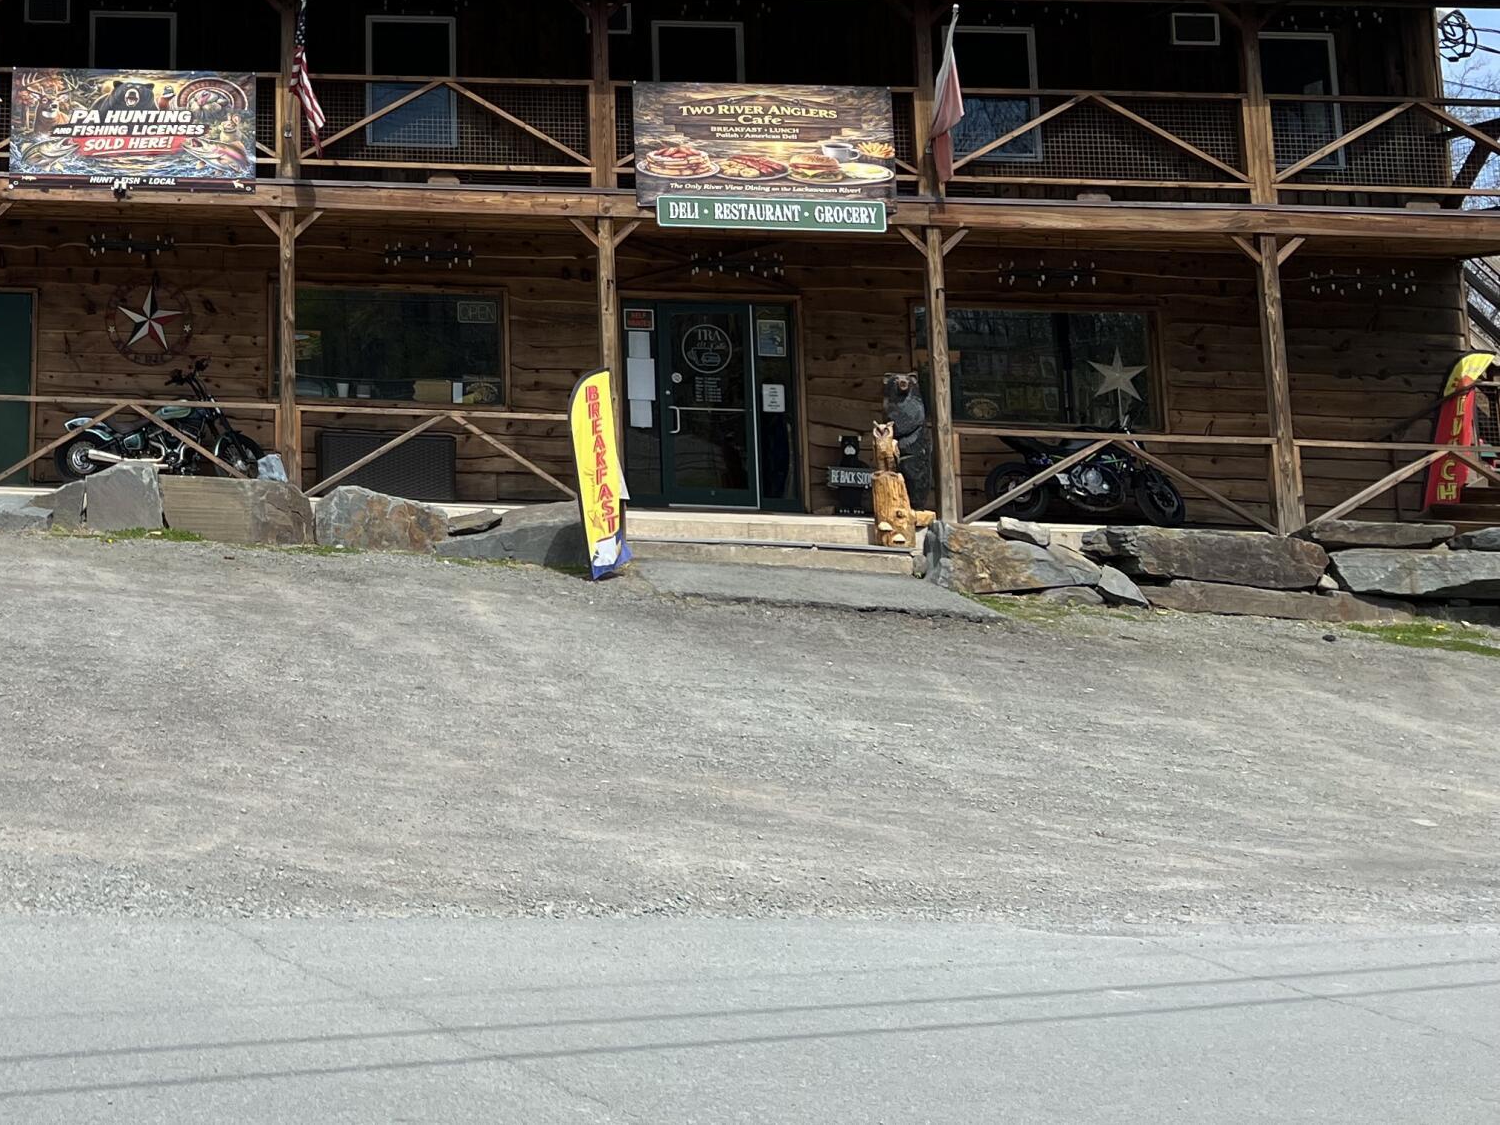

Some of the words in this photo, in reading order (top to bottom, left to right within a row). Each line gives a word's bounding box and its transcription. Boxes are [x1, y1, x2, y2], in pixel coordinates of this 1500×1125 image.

[70, 110, 100, 123] PA
[104, 110, 192, 124] HUNTING
[679, 105, 715, 116] TWO
[717, 104, 764, 115] RIVER
[767, 105, 838, 119] ANGLERS
[737, 115, 782, 125] Cafe
[53, 127, 71, 135] AND
[72, 125, 128, 136] FISHING
[131, 125, 204, 136] LICENSES
[744, 132, 781, 140] American
[83, 138, 124, 151] SOLD
[128, 137, 173, 149] HERE!
[90, 176, 114, 184] HUNT
[684, 183, 702, 191] Only
[745, 184, 770, 193] Dining
[669, 202, 699, 219] DELI
[714, 203, 801, 222] RESTAURANT
[814, 205, 877, 224] GROCERY
[1436, 395, 1466, 501] LUCH
[585, 385, 620, 534] BREAKFAST
[831, 469, 840, 484] BE
[840, 470, 856, 484] BACK
